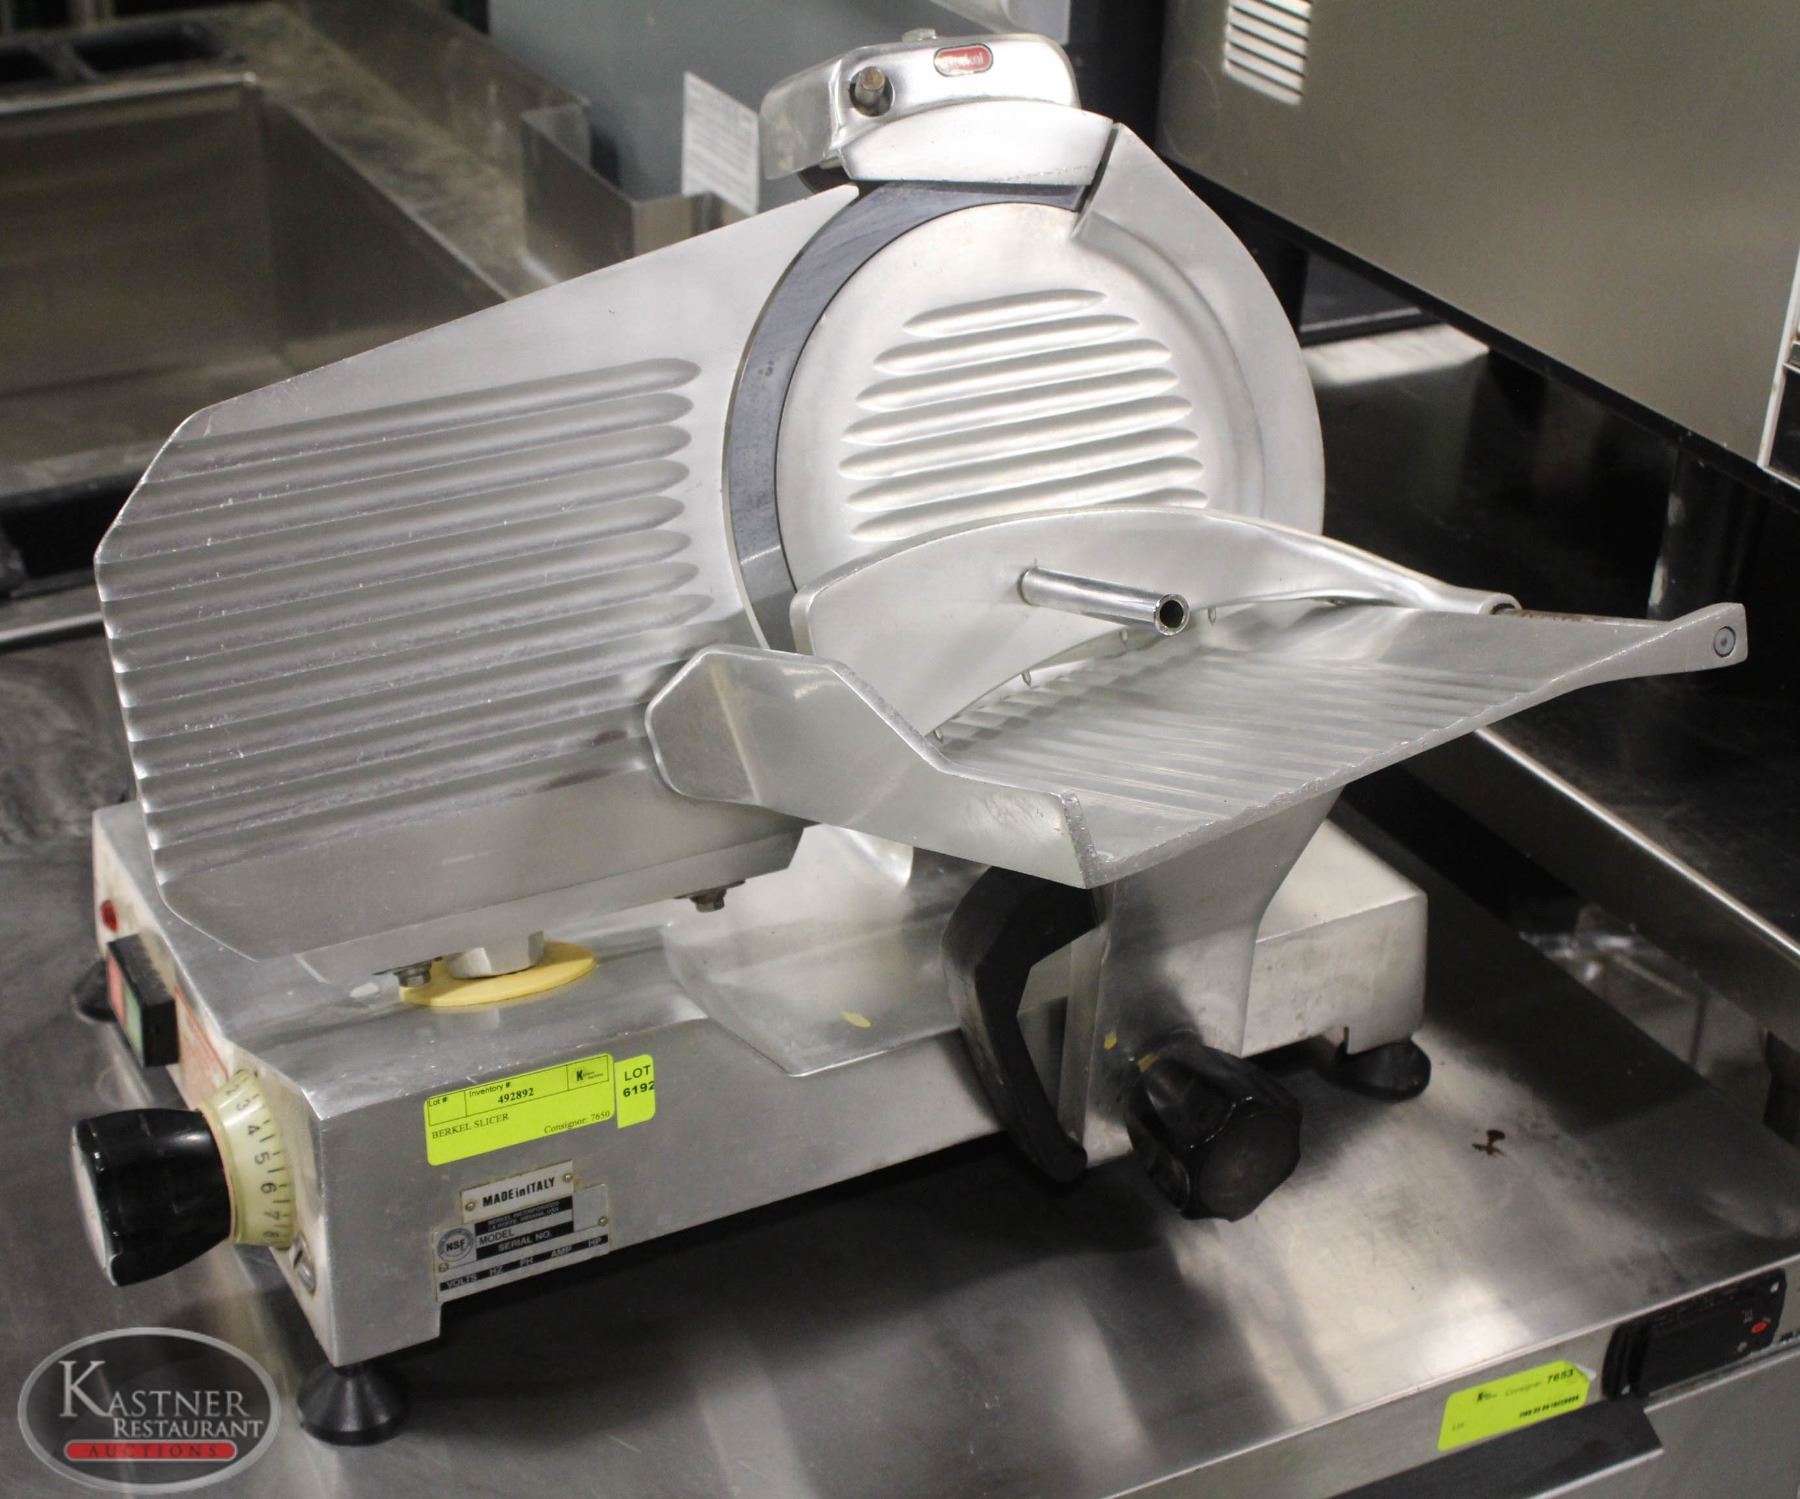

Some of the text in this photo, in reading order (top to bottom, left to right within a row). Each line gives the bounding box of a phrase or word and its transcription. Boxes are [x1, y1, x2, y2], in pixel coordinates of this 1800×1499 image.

[625, 1065, 651, 1081] LOT
[469, 1084, 503, 1098] Inventory
[497, 1088, 534, 1104] 492892
[623, 1081, 656, 1097] 6192
[428, 1099, 441, 1107] Lot
[248, 1124, 260, 1136] 4
[432, 1113, 509, 1139] BERKEL SLICER
[254, 1151, 270, 1165] 5
[260, 1182, 277, 1194] 6
[479, 1229, 515, 1245] MODEL
[446, 1239, 465, 1252] NSF
